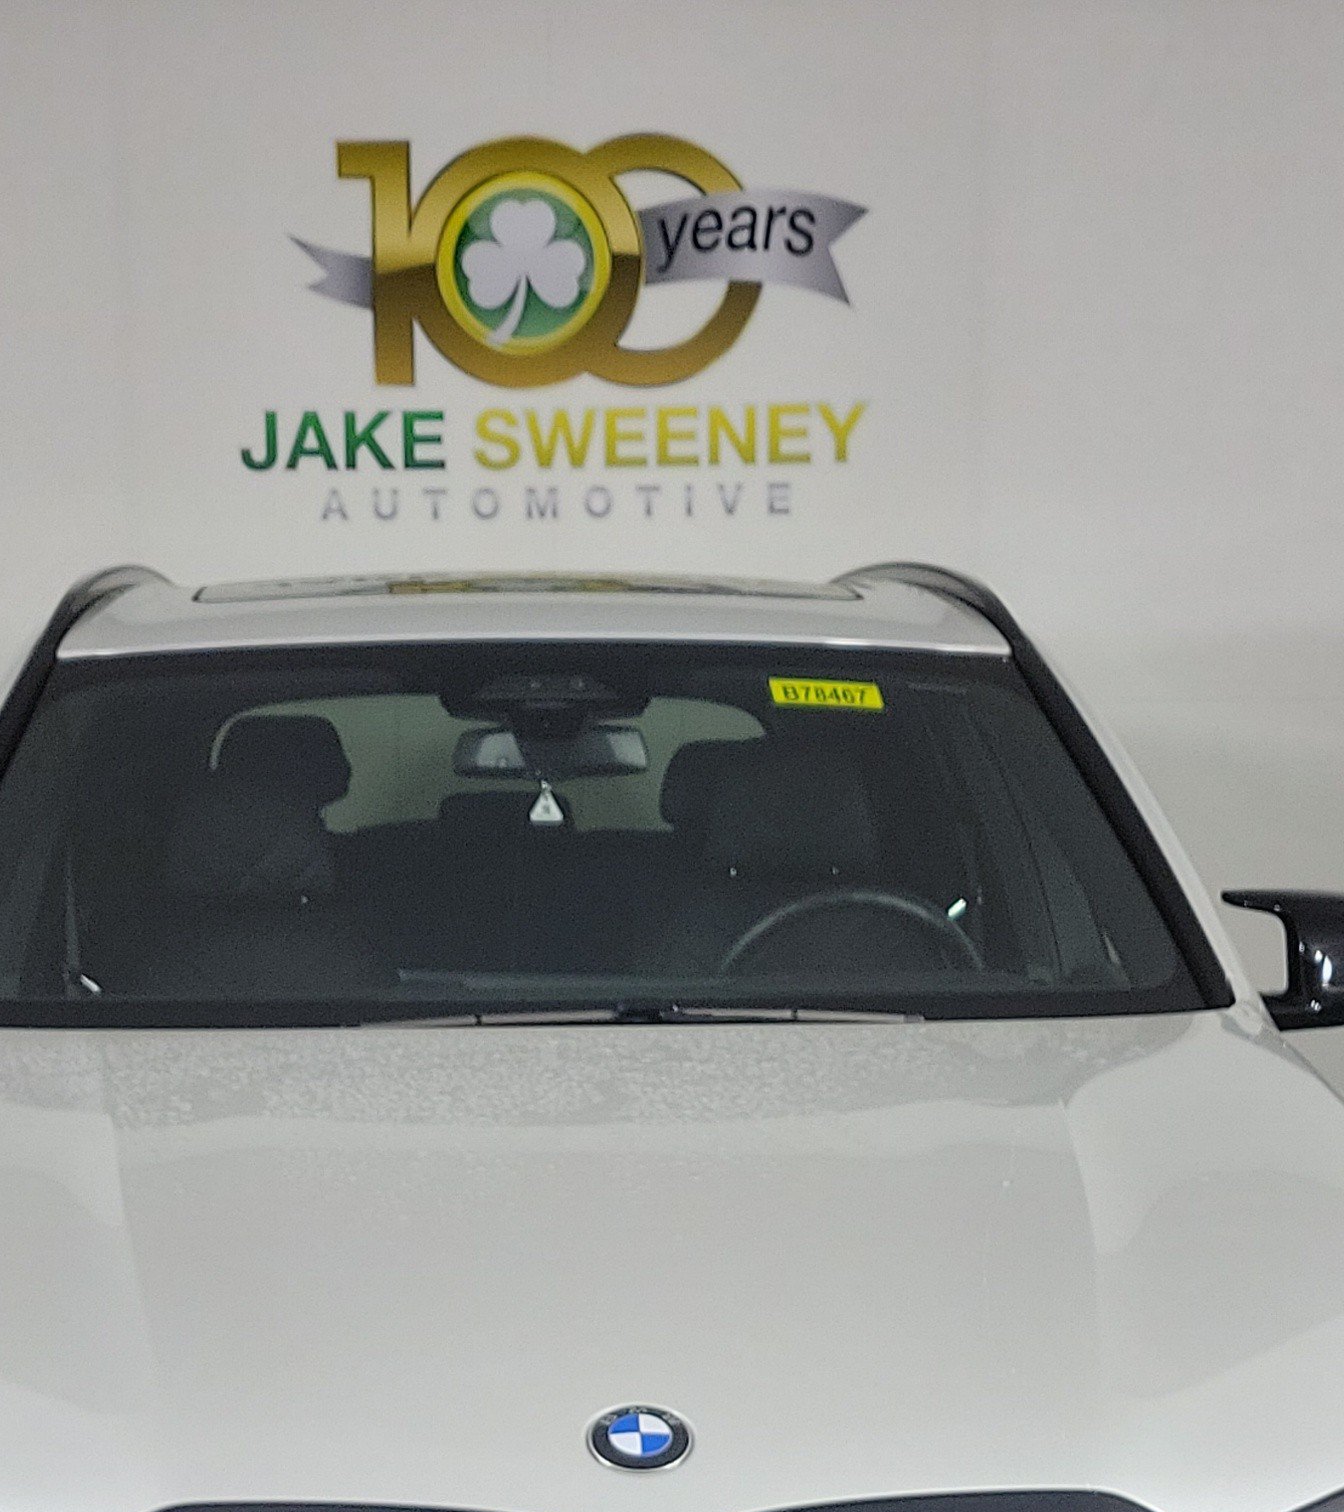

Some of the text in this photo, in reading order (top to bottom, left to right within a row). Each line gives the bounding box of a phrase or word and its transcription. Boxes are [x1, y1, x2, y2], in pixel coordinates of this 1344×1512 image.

[336, 133, 817, 387] 100 years
[240, 401, 869, 472] JAKE SWEENEY
[320, 482, 794, 521] AUTOMOTIVE
